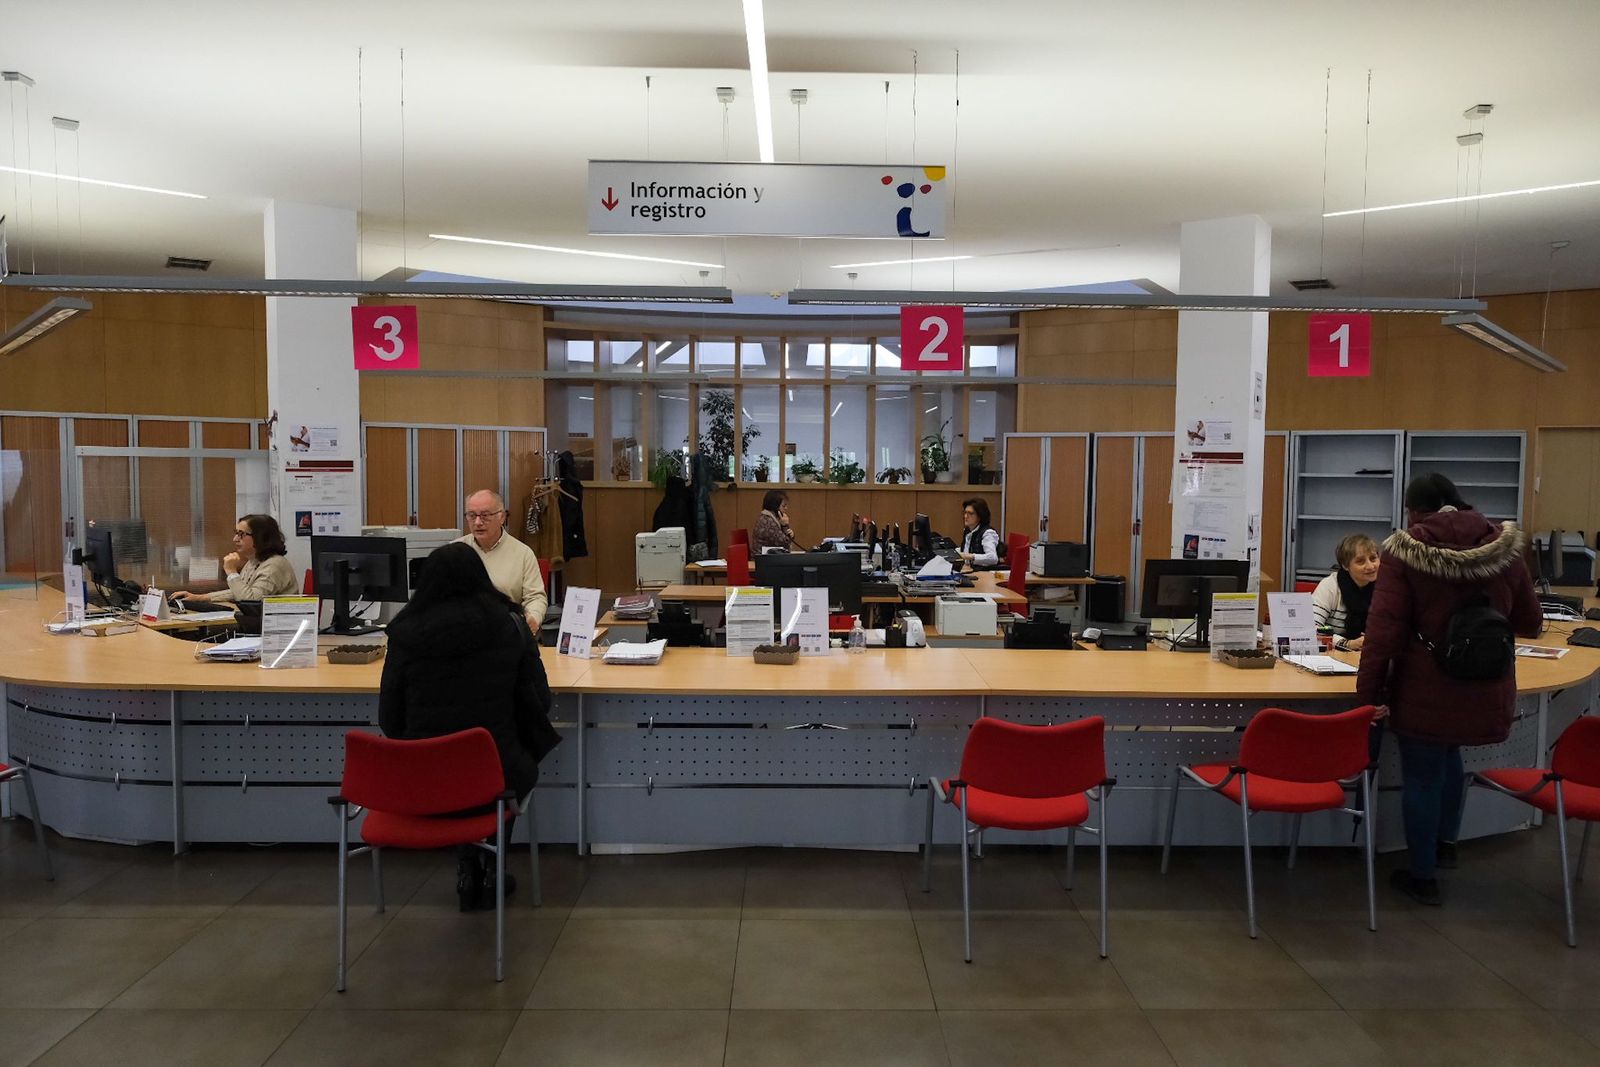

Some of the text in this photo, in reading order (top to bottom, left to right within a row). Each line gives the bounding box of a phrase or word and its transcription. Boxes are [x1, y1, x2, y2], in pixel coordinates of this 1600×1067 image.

[631, 182, 765, 203] Información y
[631, 202, 706, 222] registro
[371, 315, 404, 361] 3
[918, 316, 949, 362] 2
[1329, 325, 1350, 368] 1
